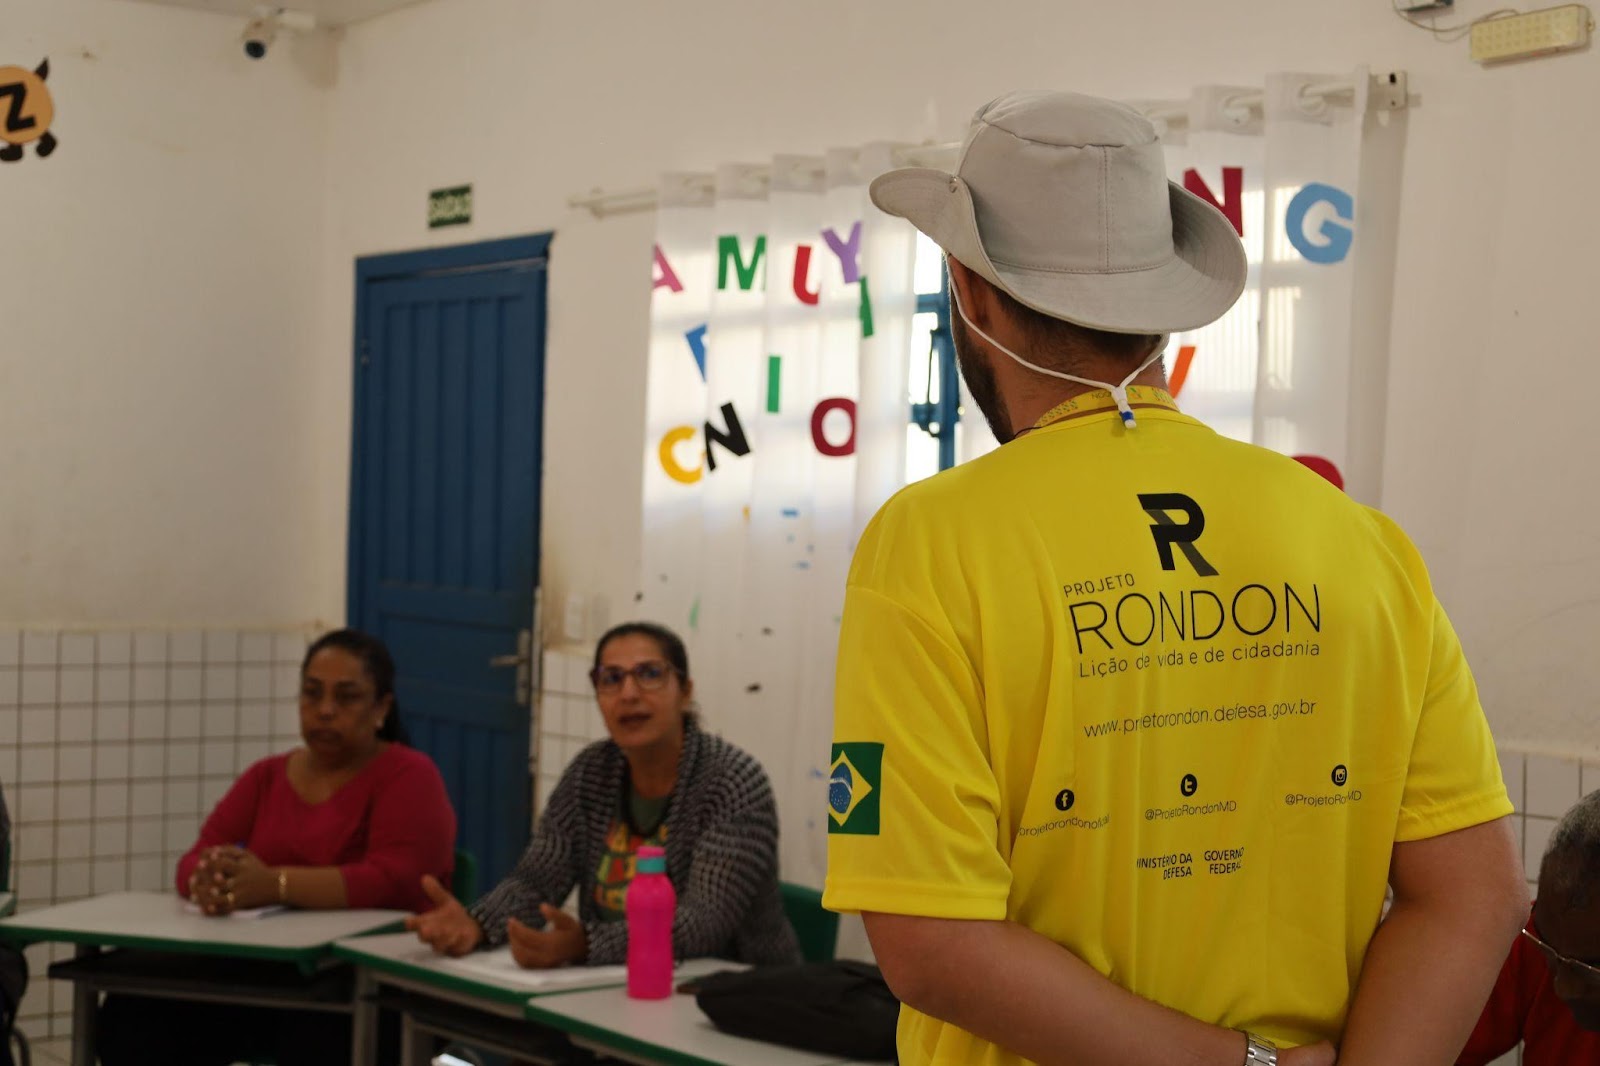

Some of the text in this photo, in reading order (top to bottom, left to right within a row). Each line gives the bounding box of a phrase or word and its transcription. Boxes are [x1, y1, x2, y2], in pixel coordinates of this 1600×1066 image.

[1183, 167, 1244, 237] N
[1285, 182, 1354, 265] G
[718, 235, 766, 290] M
[821, 221, 863, 284] Y
[659, 425, 704, 484] C
[703, 402, 751, 472] N
[810, 397, 857, 457] O
[1137, 493, 1219, 577] R
[1063, 573, 1135, 598] PROJETO
[1068, 582, 1320, 654] RONDON
[1080, 640, 1320, 678] Lição de vida e de cidadania
[1145, 800, 1237, 820] @ProjetoRondonMD
[1163, 866, 1193, 880] DEFESA
[1180, 853, 1193, 864] DA
